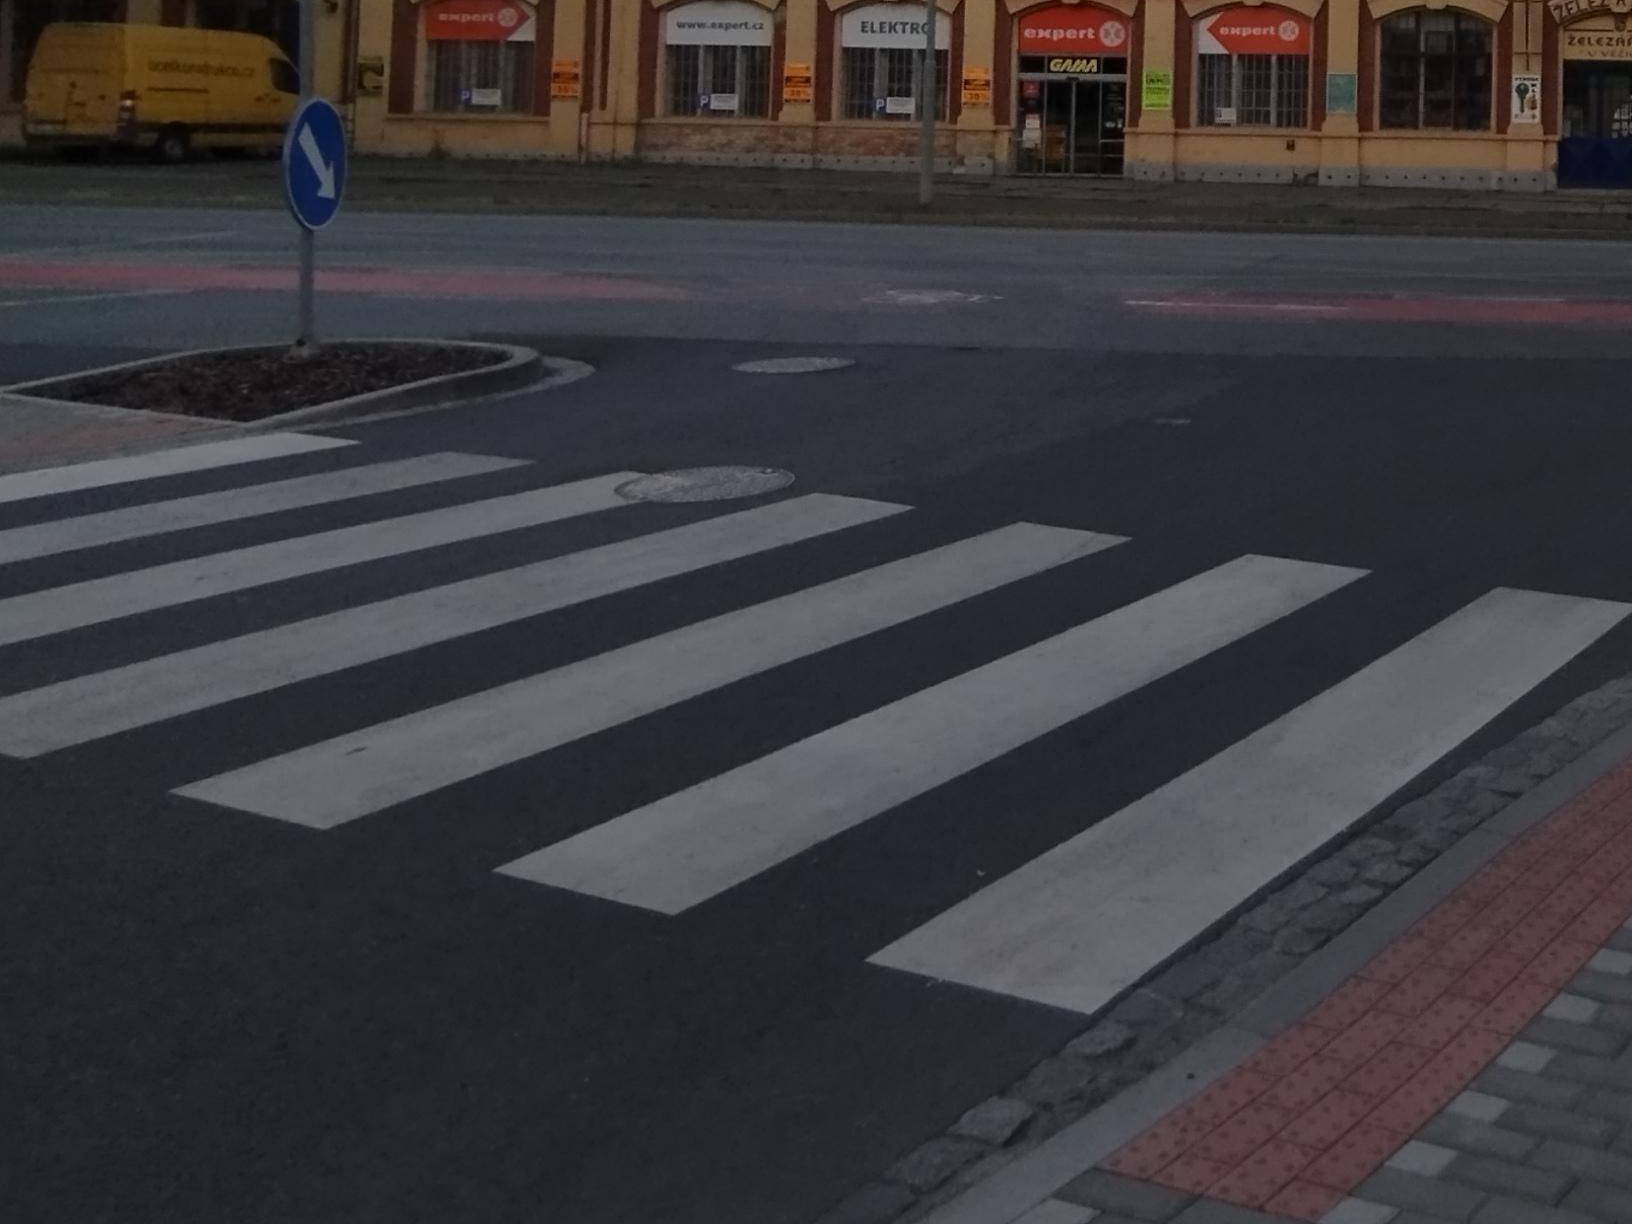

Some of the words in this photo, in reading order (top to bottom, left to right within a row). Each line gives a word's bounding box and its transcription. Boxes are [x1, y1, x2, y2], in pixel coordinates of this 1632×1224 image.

[438, 12, 495, 23] expert
[676, 21, 764, 32] www.expert.cz
[1219, 26, 1276, 37] expert
[1023, 27, 1096, 41] expert
[1049, 58, 1098, 73] GAMA
